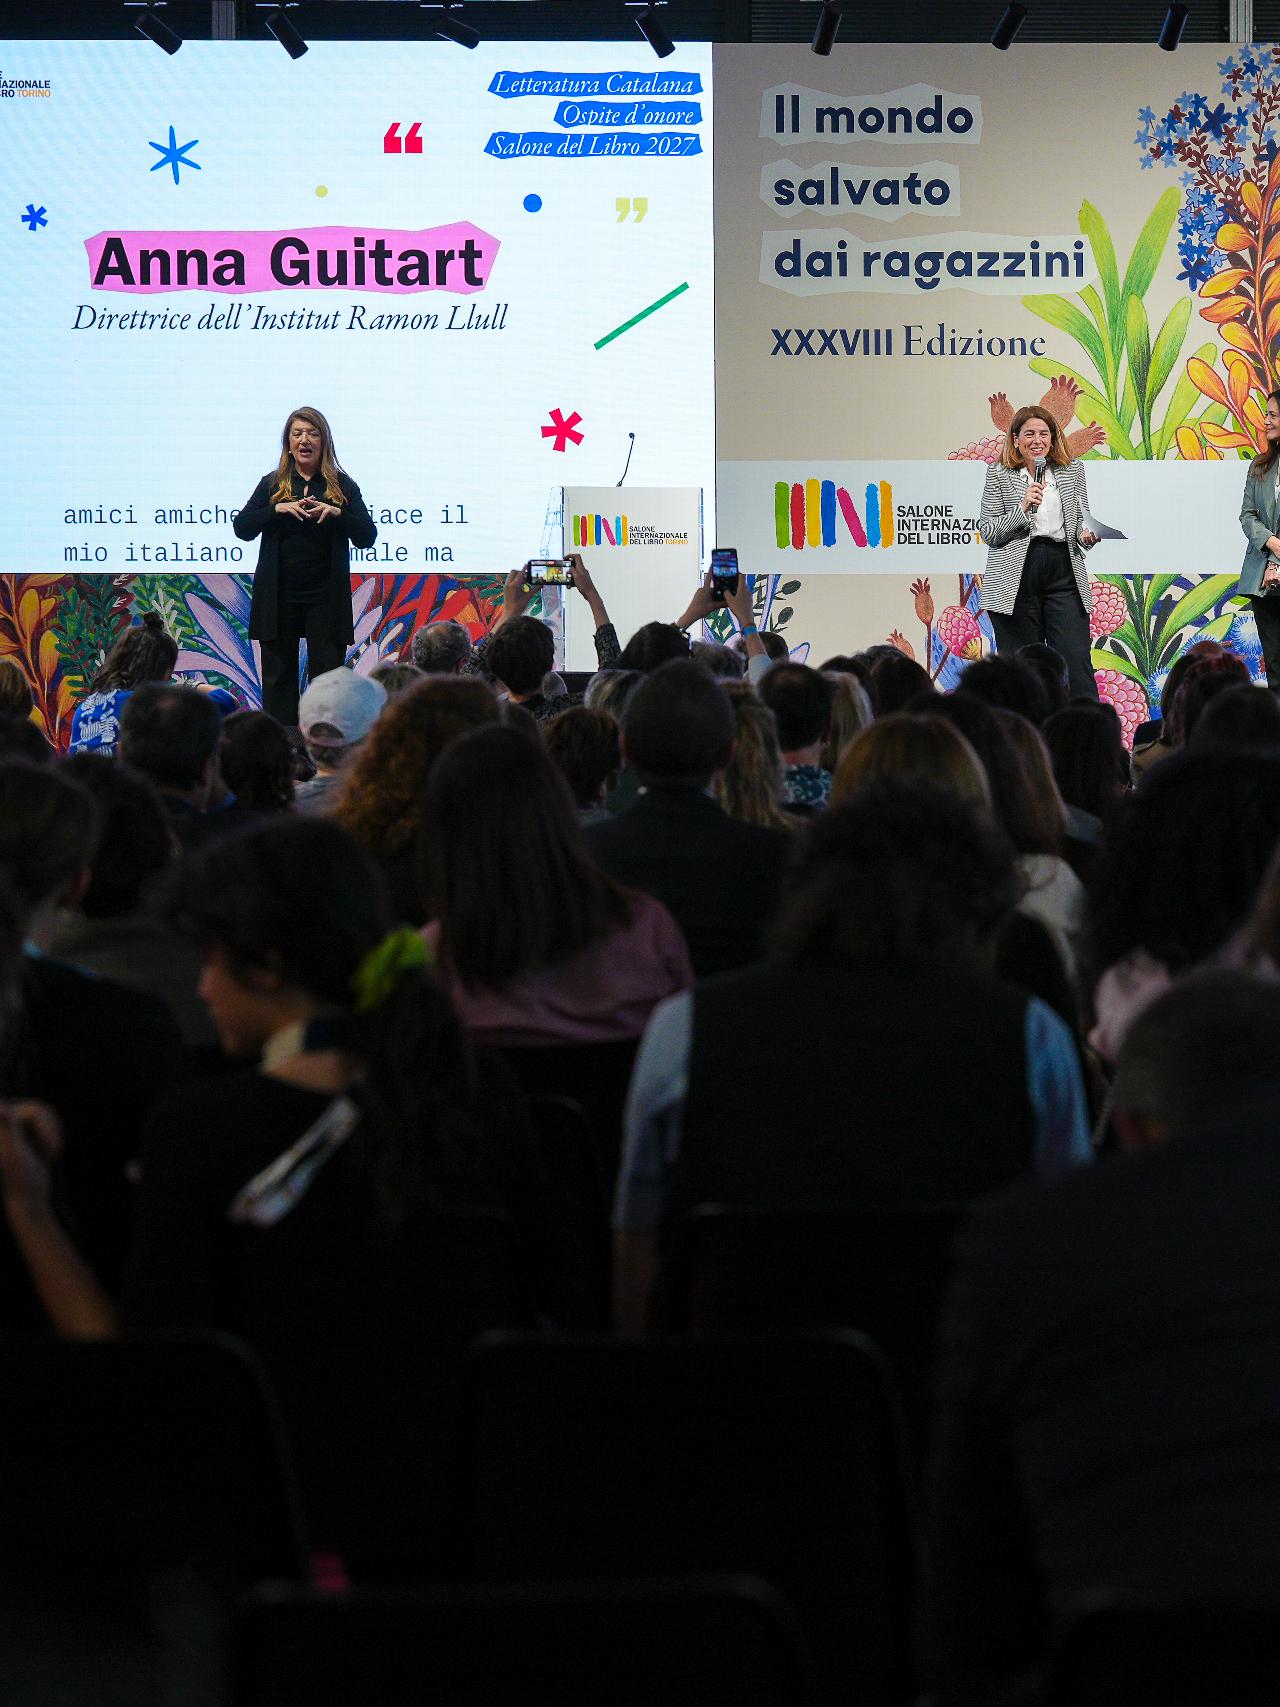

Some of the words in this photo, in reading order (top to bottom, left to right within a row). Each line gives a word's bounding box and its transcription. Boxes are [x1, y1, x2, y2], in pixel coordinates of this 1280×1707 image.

[0, 79, 51, 89] AZIONALE
[495, 73, 600, 93] Letteratura
[606, 72, 693, 93] Catalana
[17, 89, 51, 98] TORINO
[563, 104, 621, 126] Ospite
[625, 103, 694, 124] d'onore
[775, 94, 800, 133] Il
[815, 95, 974, 135] mondo
[491, 134, 552, 155] Salone
[556, 134, 585, 155] del
[586, 135, 640, 155] Libro
[645, 136, 697, 156] 2027
[774, 167, 952, 208] salvato
[93, 238, 245, 286] Anna
[271, 237, 483, 286] Guitart
[774, 238, 848, 278] dai
[863, 240, 1084, 292] ragazzini
[71, 305, 191, 330] Direttrice
[346, 306, 438, 330] Ramon
[445, 304, 508, 329] Llull
[771, 328, 893, 356] XXXVIII
[902, 323, 1047, 359] Edizione
[65, 505, 137, 524] amici
[154, 504, 240, 524] amiche
[441, 505, 468, 523] il
[897, 505, 953, 517] SALONE
[628, 525, 656, 533] SALONE
[898, 533, 923, 544] DEL
[928, 533, 971, 544] LIBRO
[65, 543, 107, 561] mio
[125, 542, 243, 562] italiano
[350, 542, 408, 562] male
[426, 547, 454, 561] ma
